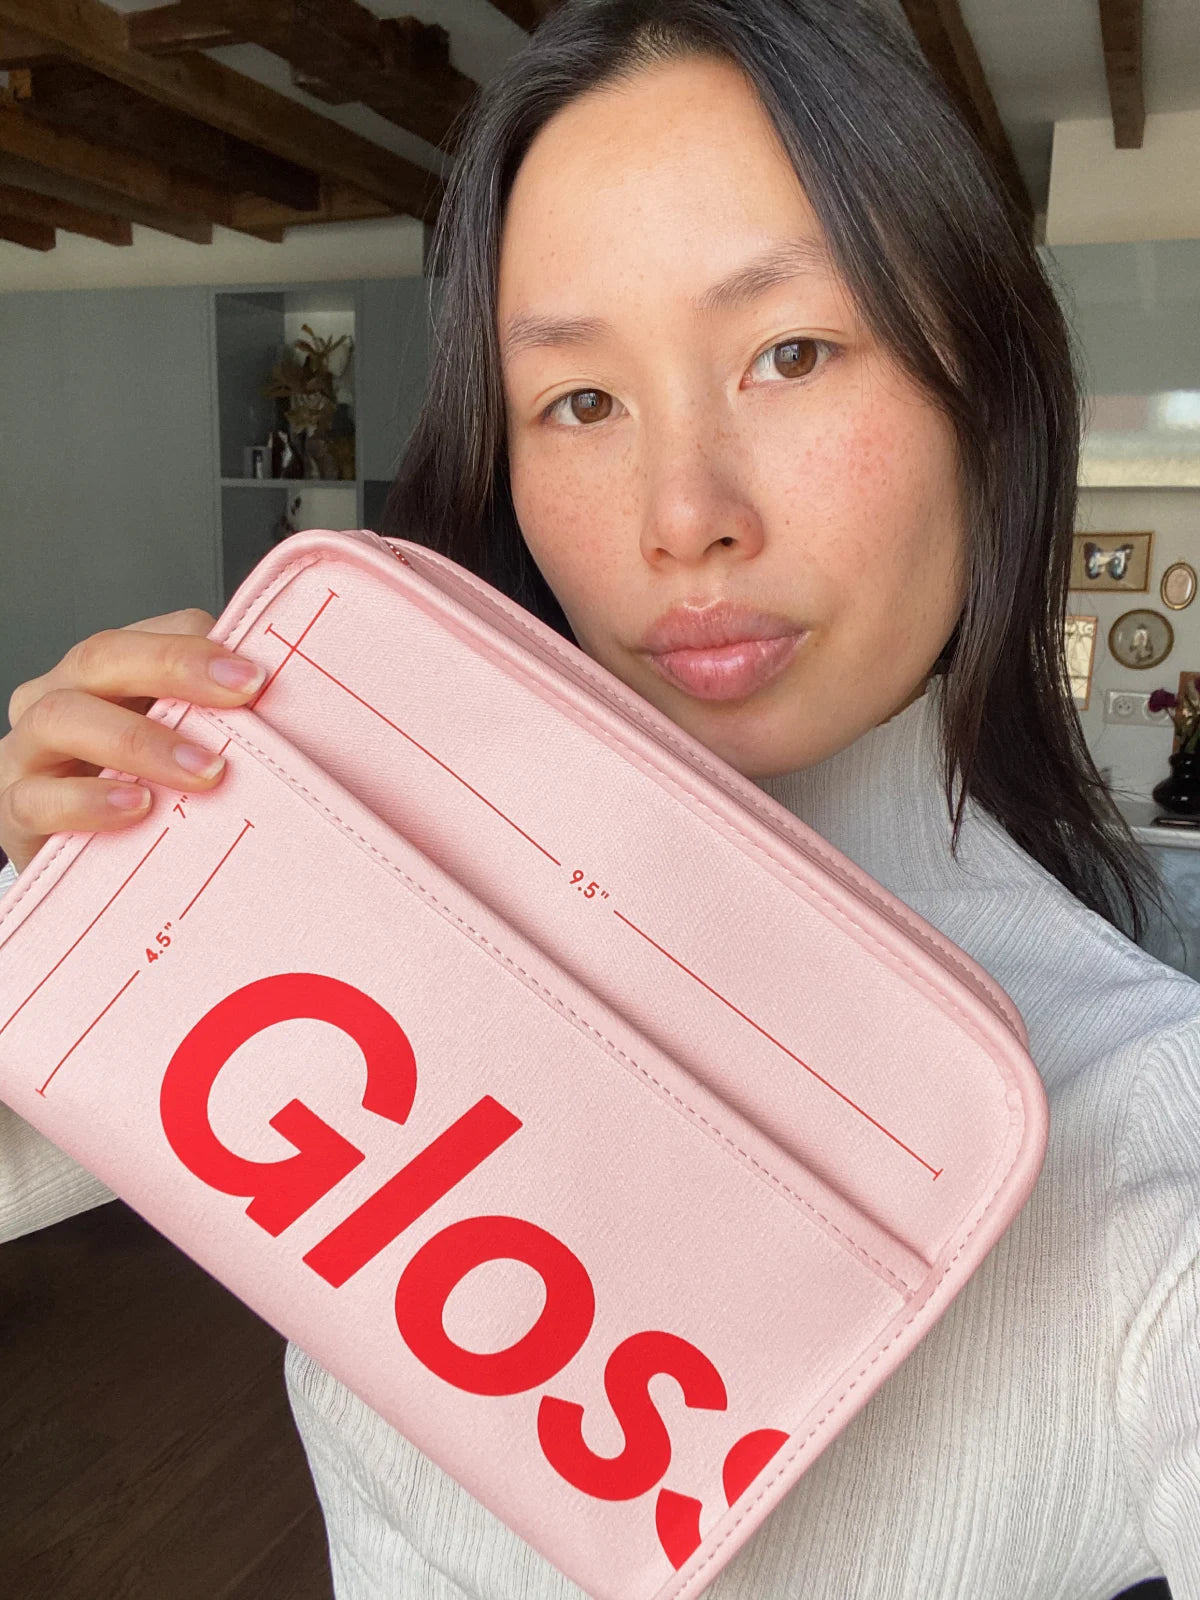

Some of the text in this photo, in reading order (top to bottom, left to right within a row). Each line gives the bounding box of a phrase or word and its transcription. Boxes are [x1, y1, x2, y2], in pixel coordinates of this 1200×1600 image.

[172, 794, 189, 819] 7"
[569, 869, 610, 899] 9.5"
[145, 921, 172, 963] 4.5"
